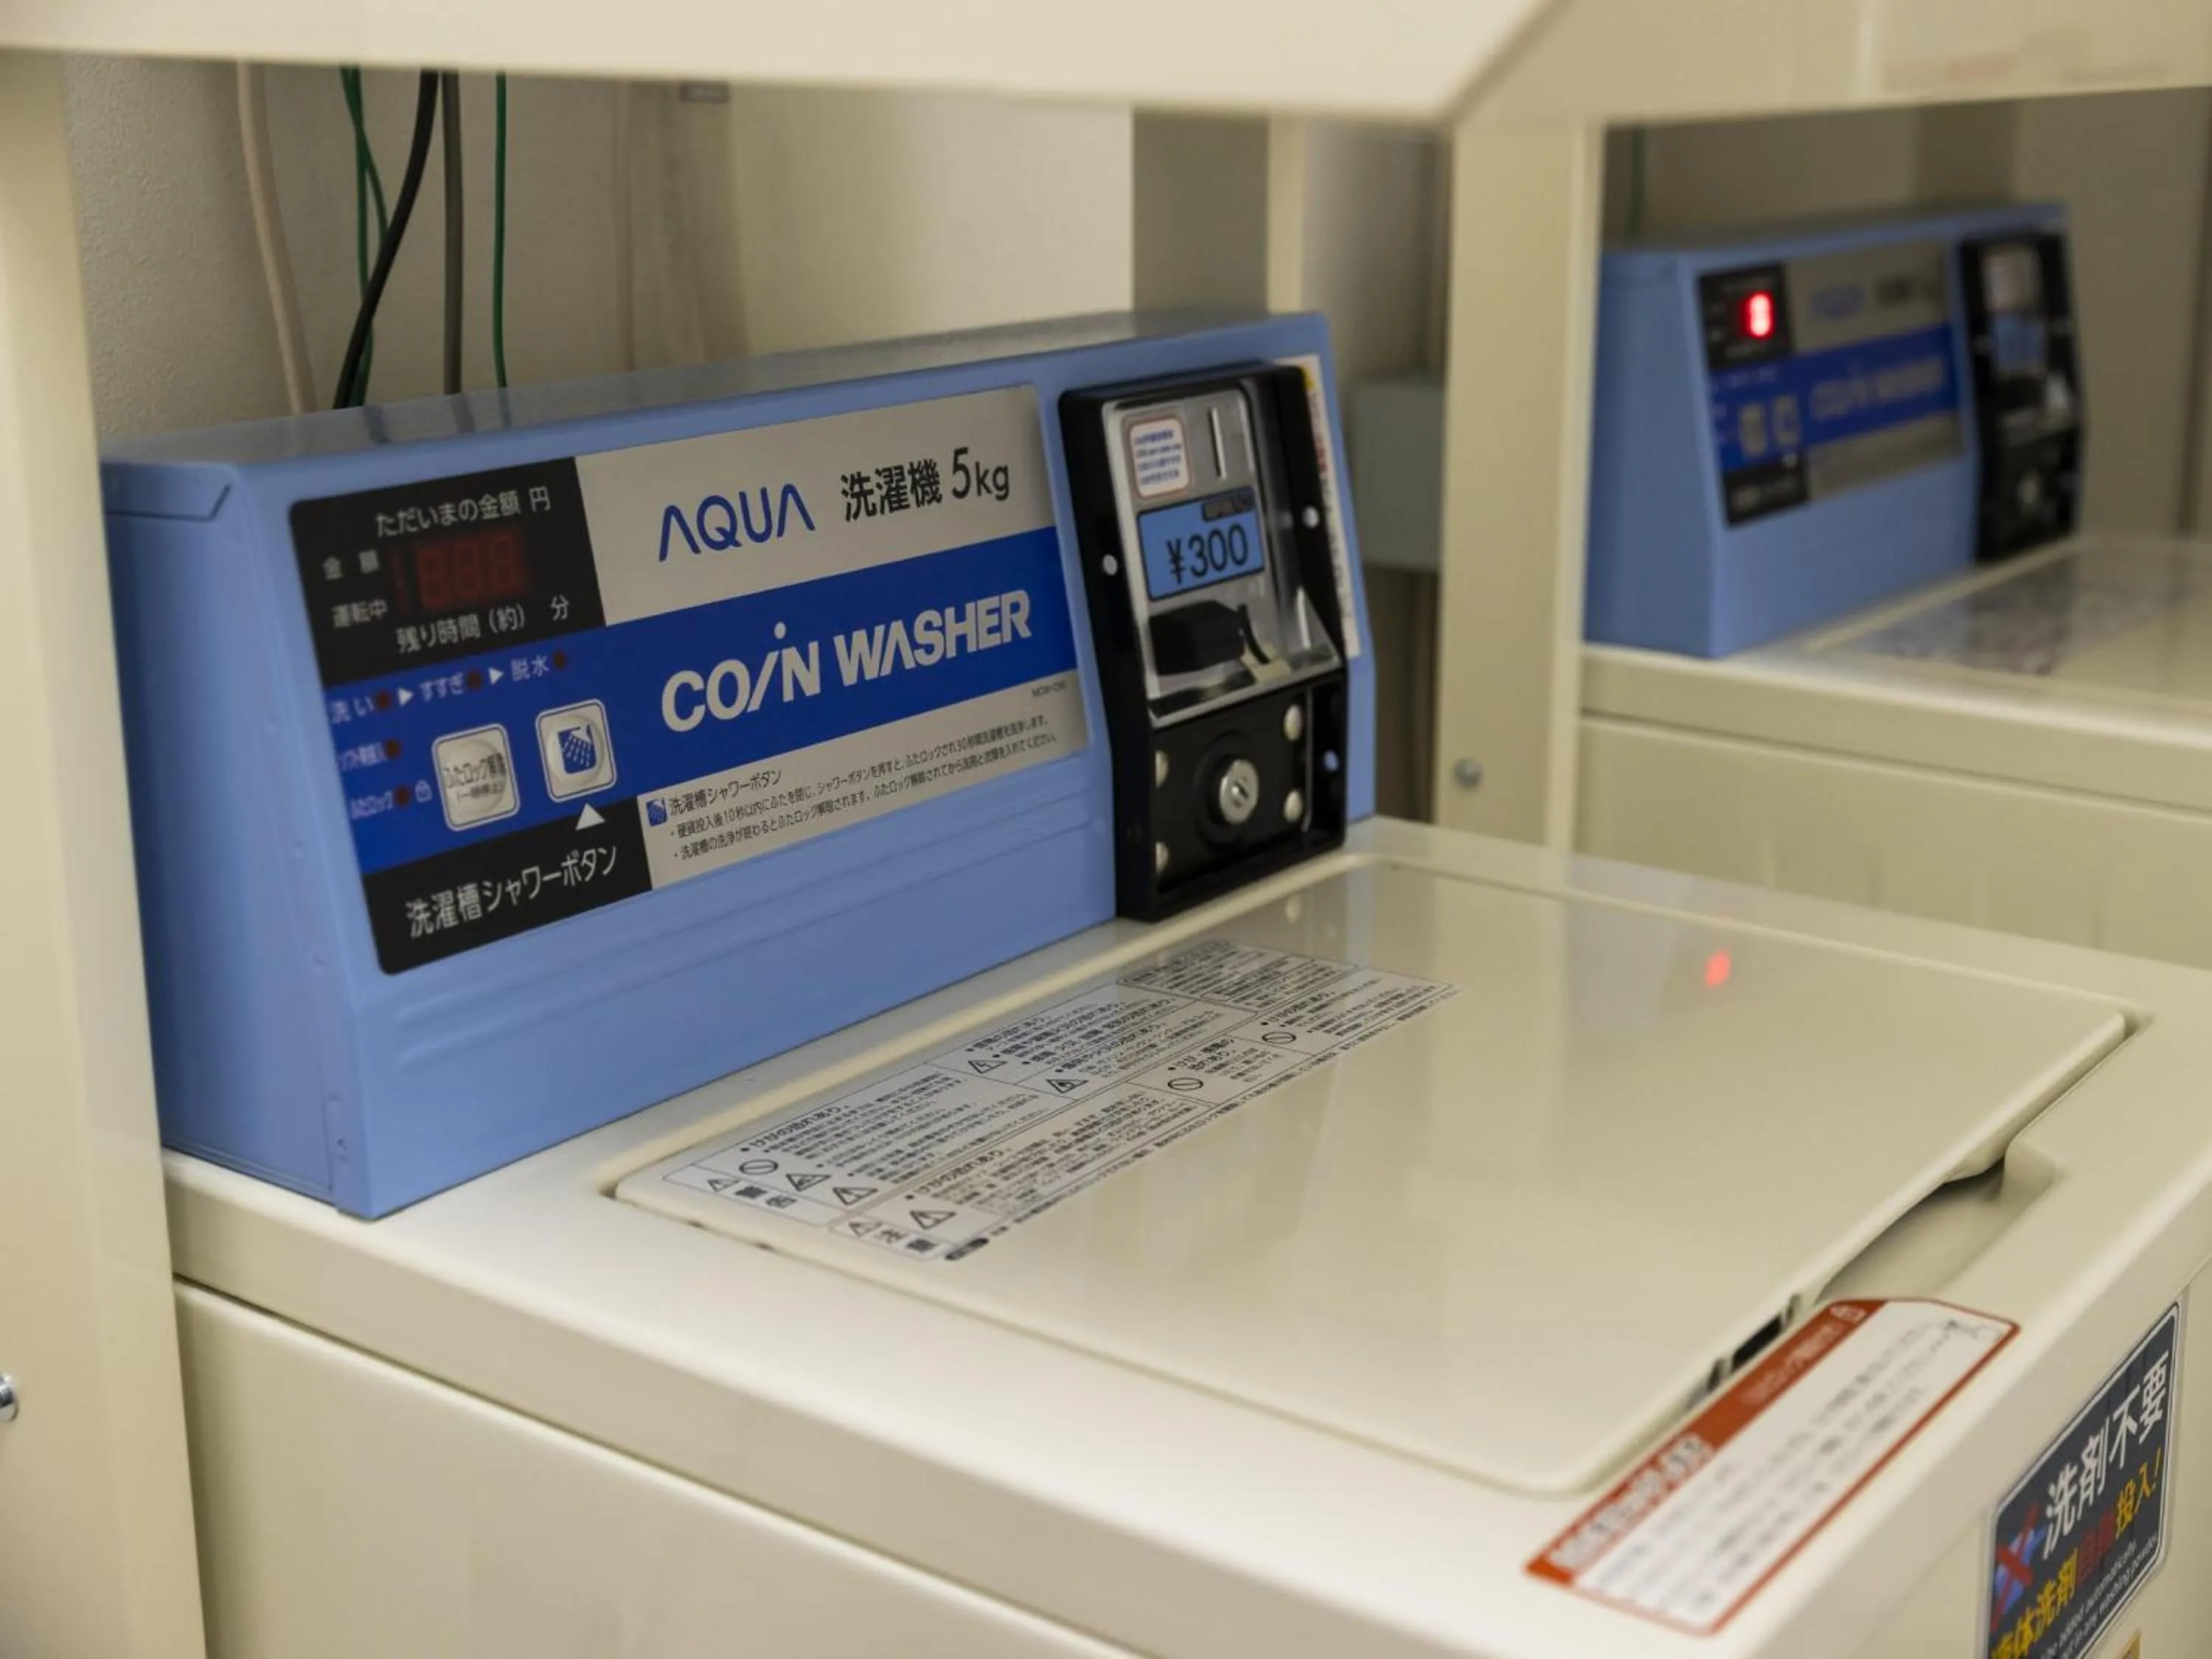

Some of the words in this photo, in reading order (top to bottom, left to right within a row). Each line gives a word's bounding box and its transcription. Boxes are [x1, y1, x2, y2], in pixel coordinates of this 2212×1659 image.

[375, 490, 521, 538] ただいまの金額
[658, 483, 816, 562] AQUA
[840, 458, 944, 523] 洗濯機
[950, 446, 1011, 501] 5kg
[1166, 524, 1250, 585] ¥300
[661, 621, 821, 733] COIN
[832, 588, 1032, 688] WASHER
[667, 769, 782, 817] 洗濯槽シャワーボタン
[406, 846, 618, 939] 洗濯槽シャワーボタン
[2042, 1351, 2168, 1560] 洗剤不要
